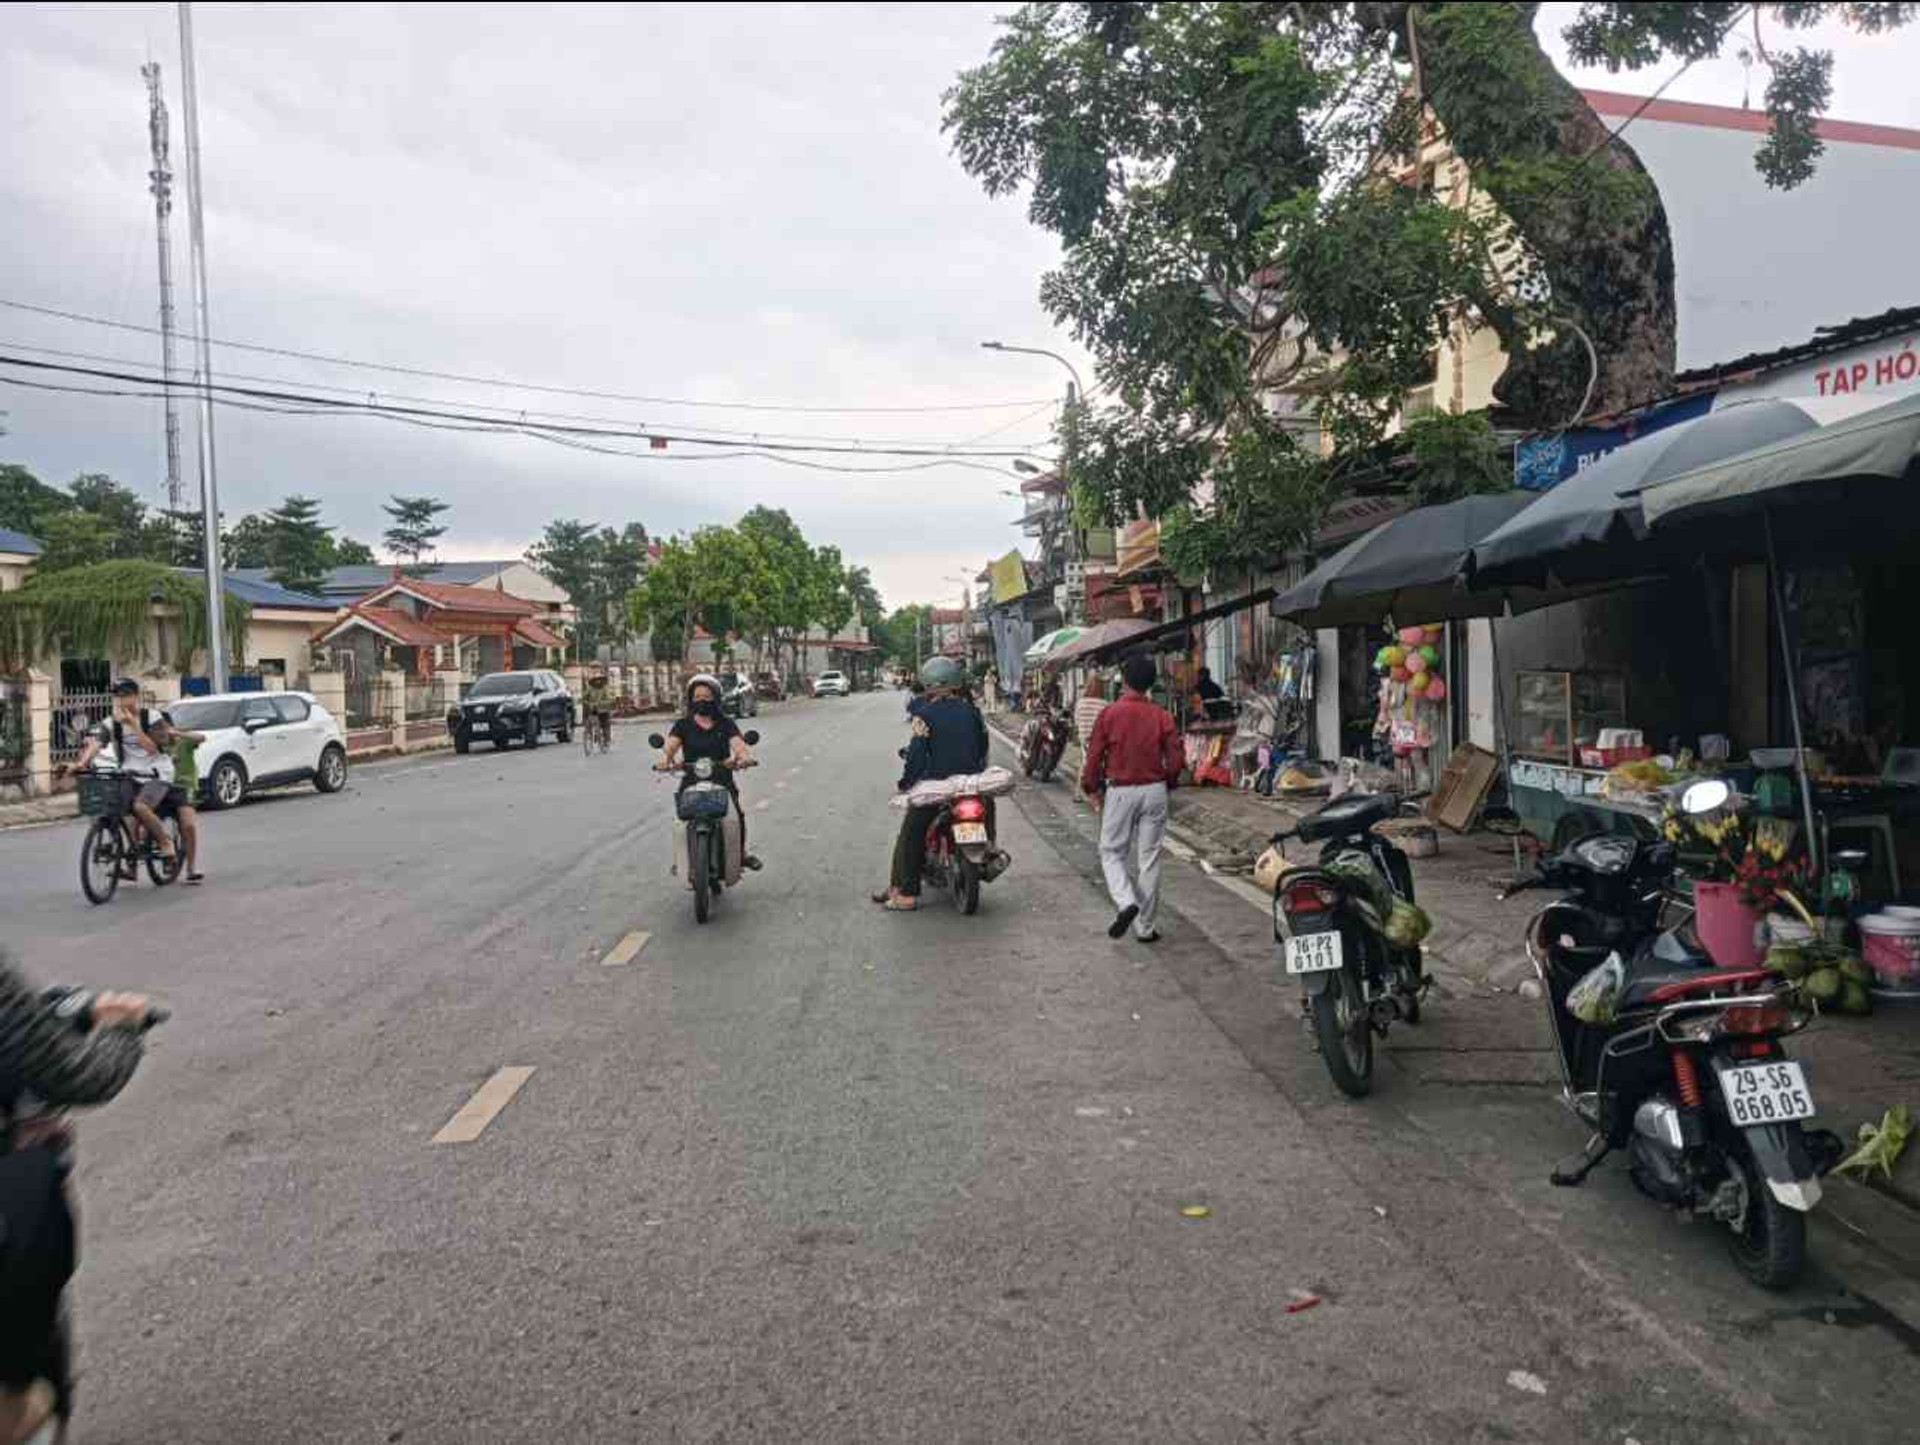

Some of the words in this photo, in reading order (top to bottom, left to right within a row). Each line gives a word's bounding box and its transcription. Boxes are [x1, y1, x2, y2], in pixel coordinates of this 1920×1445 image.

[1875, 336, 1920, 386] HÓ
[1732, 1065, 1792, 1095] 29-S6
[1733, 1090, 1808, 1121] 868.05
